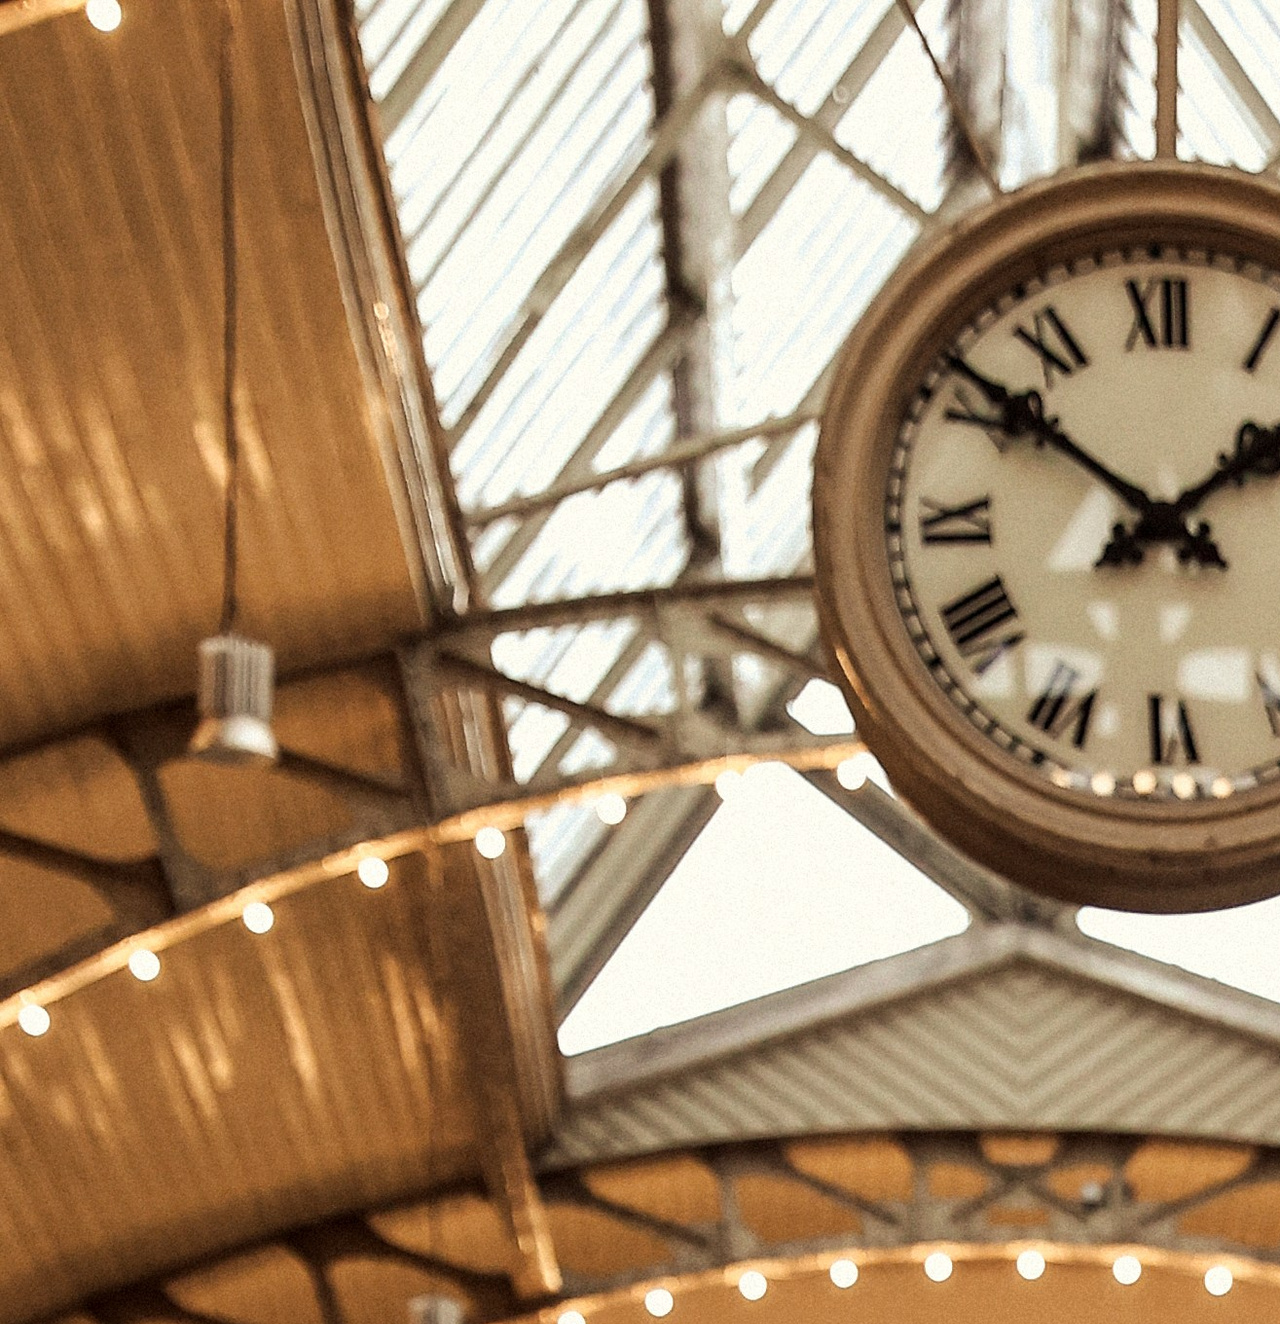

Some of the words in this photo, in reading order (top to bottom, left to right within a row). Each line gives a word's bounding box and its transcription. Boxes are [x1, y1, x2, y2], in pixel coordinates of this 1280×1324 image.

[1013, 305, 1090, 389] XI
[1126, 277, 1190, 352] XII
[918, 494, 992, 547] IX
[940, 574, 1027, 679] VIII
[1028, 660, 1097, 750] VII
[1148, 694, 1201, 766] VI
